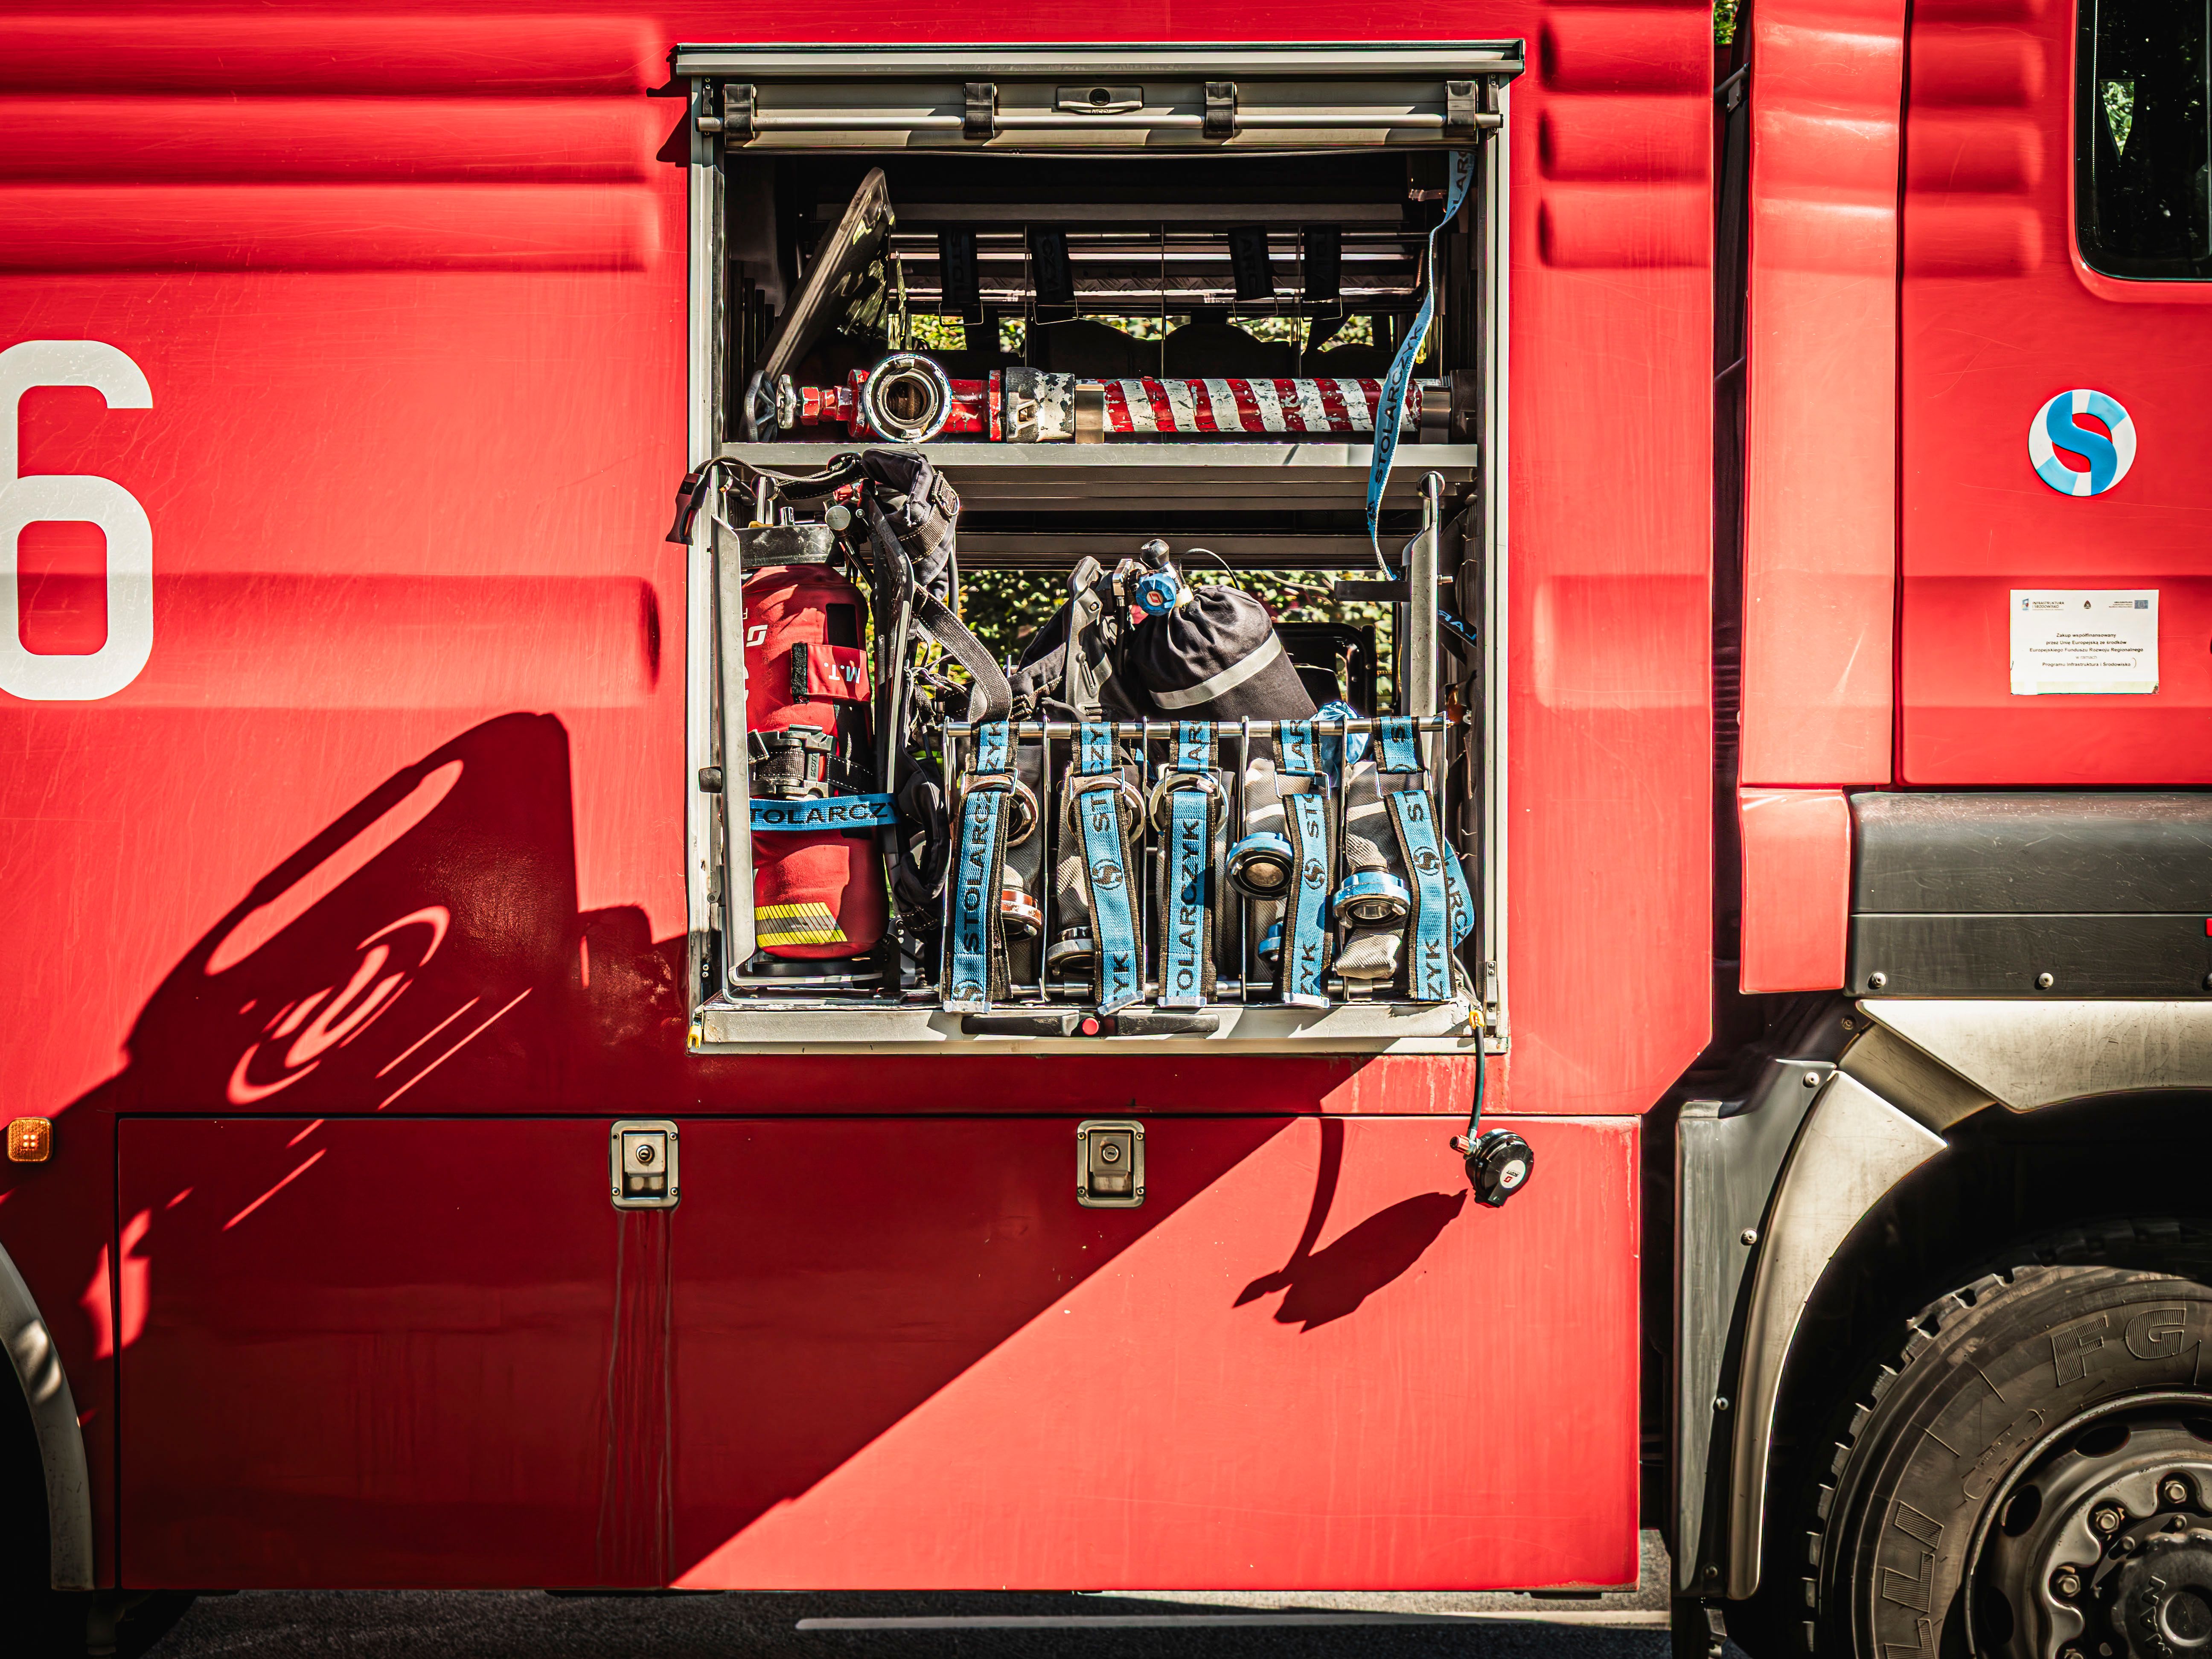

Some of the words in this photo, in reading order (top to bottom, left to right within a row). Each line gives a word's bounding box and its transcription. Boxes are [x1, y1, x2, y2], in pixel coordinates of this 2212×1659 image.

[1375, 326, 1423, 485] STOLARCZYK
[0, 340, 153, 701] 6
[1176, 819, 1199, 997] OLARCZYK
